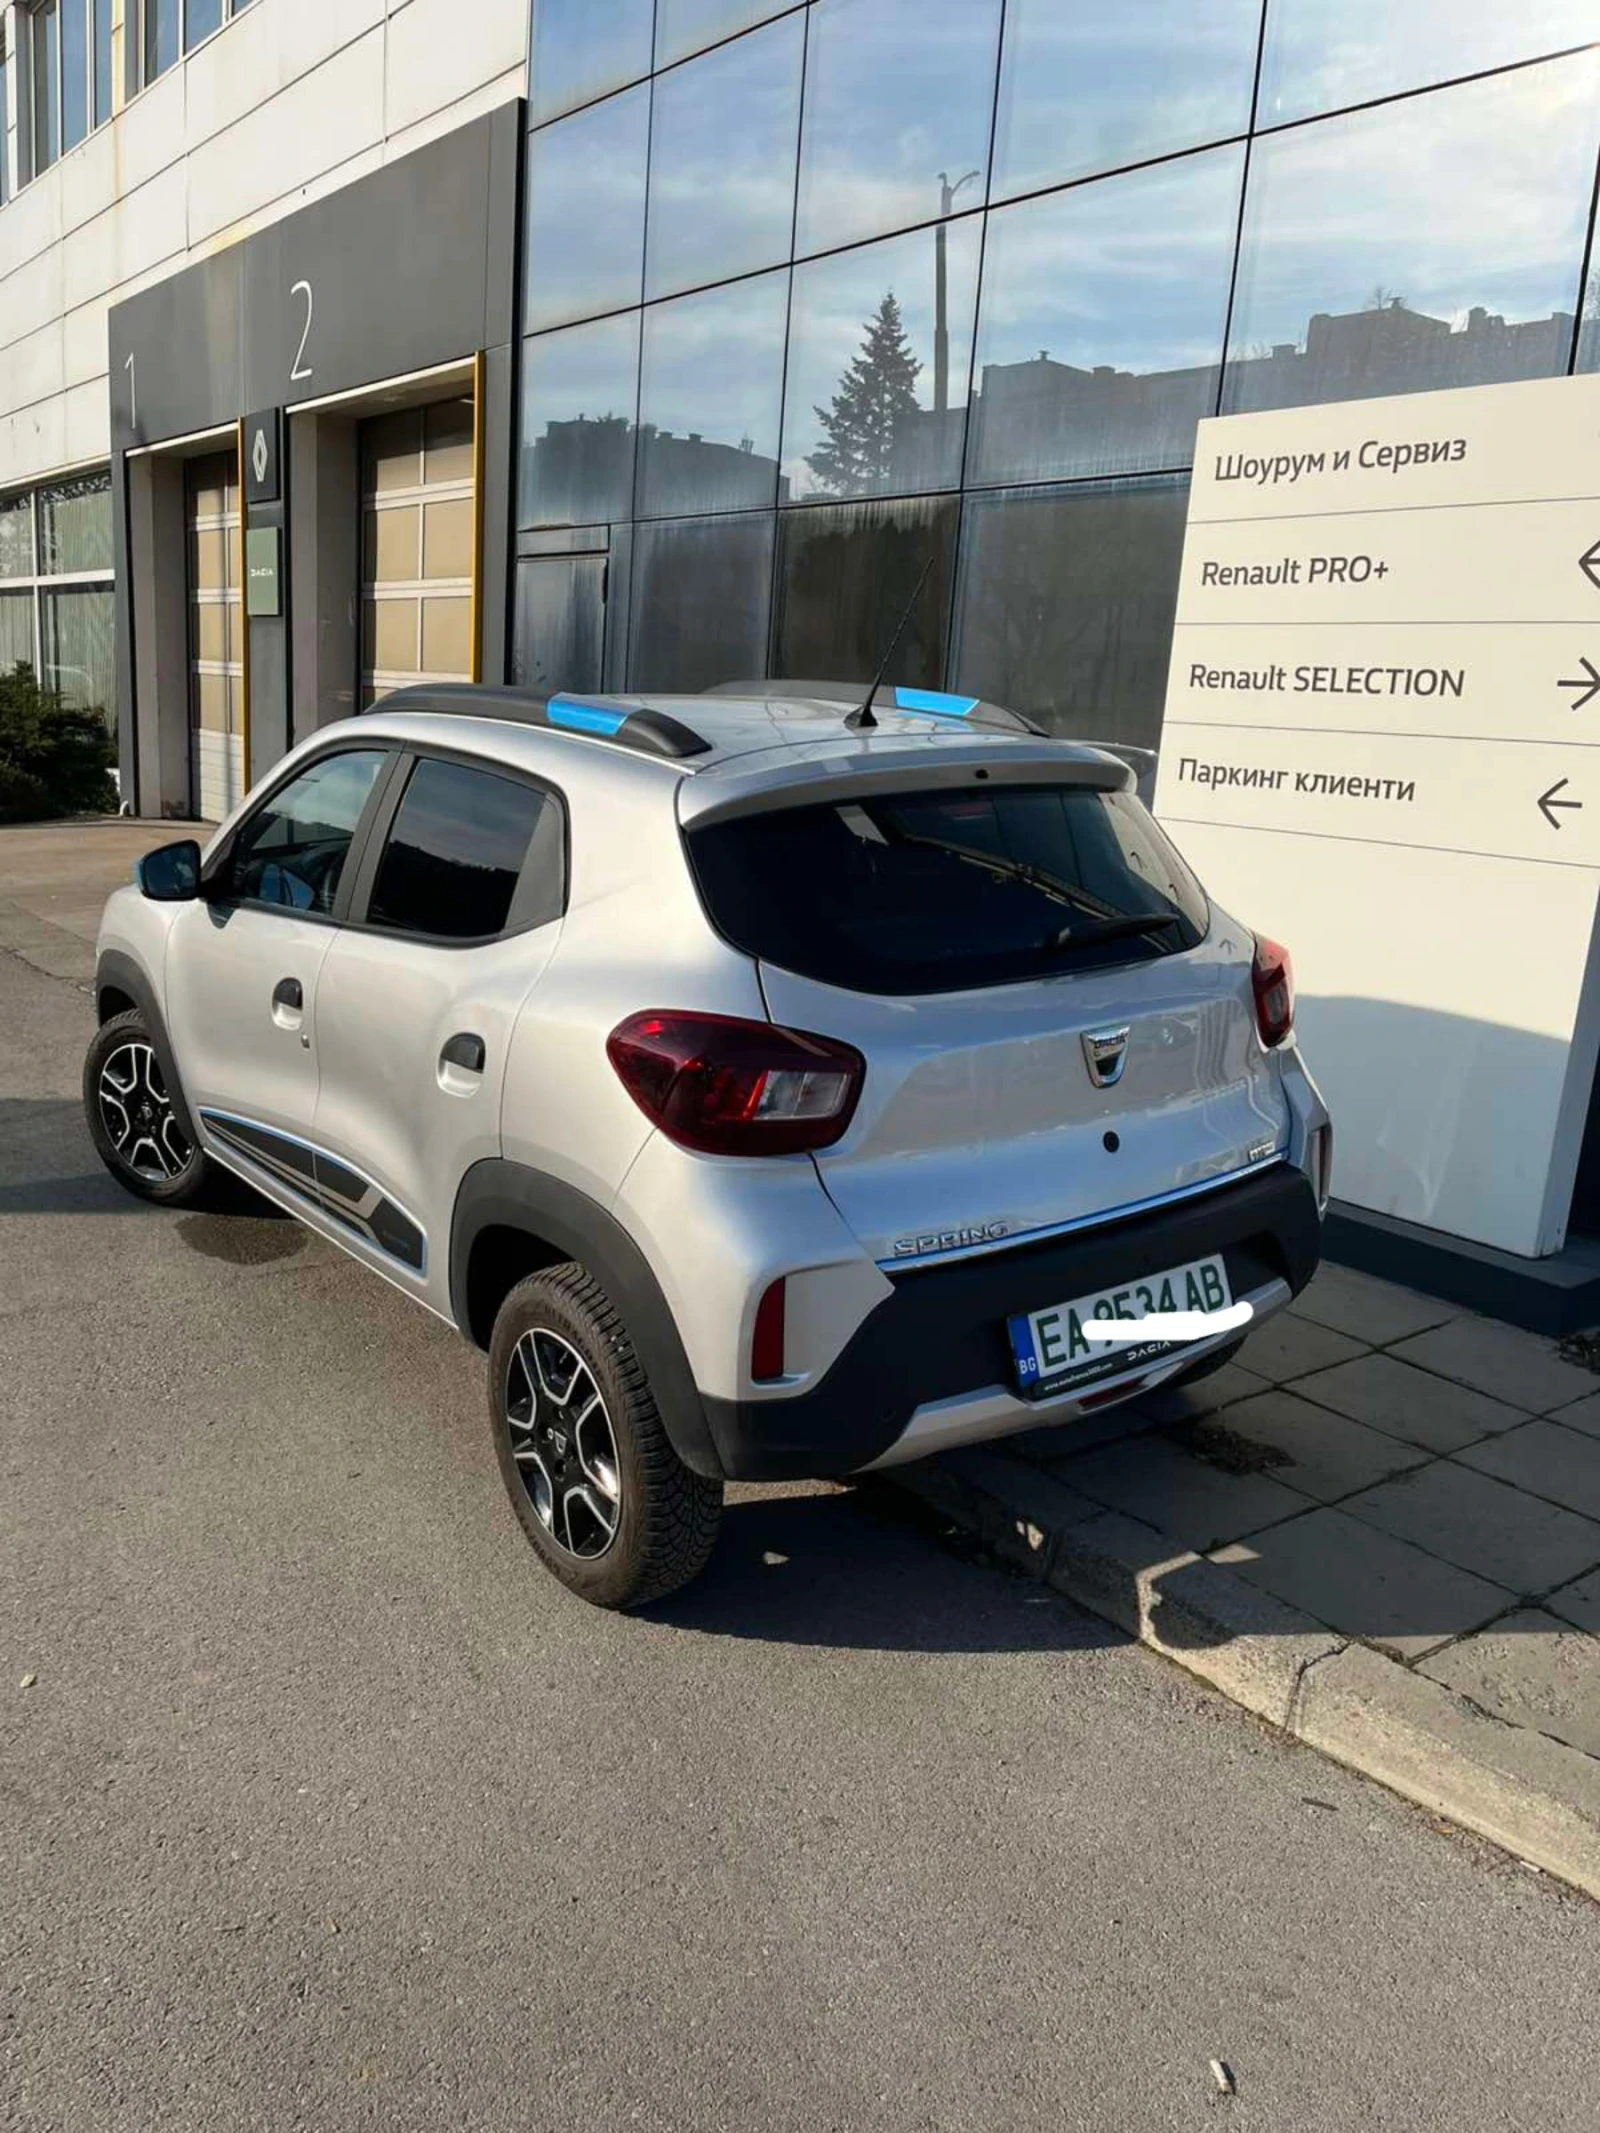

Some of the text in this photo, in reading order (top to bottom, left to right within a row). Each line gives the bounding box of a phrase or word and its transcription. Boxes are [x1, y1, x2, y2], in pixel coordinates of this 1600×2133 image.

[290, 280, 313, 381] 2
[124, 352, 136, 429] 1
[1214, 438, 1467, 485] Шоурум и Сервиз
[1200, 555, 1389, 587] Renault PRO+
[1189, 664, 1465, 697] Renault SELECTION
[1178, 758, 1416, 802] Паркинг клиенти
[893, 1220, 1009, 1257] SPRING
[1036, 1308, 1091, 1368] EA
[1185, 1262, 1226, 1314] AB
[1019, 1355, 1037, 1376] BG
